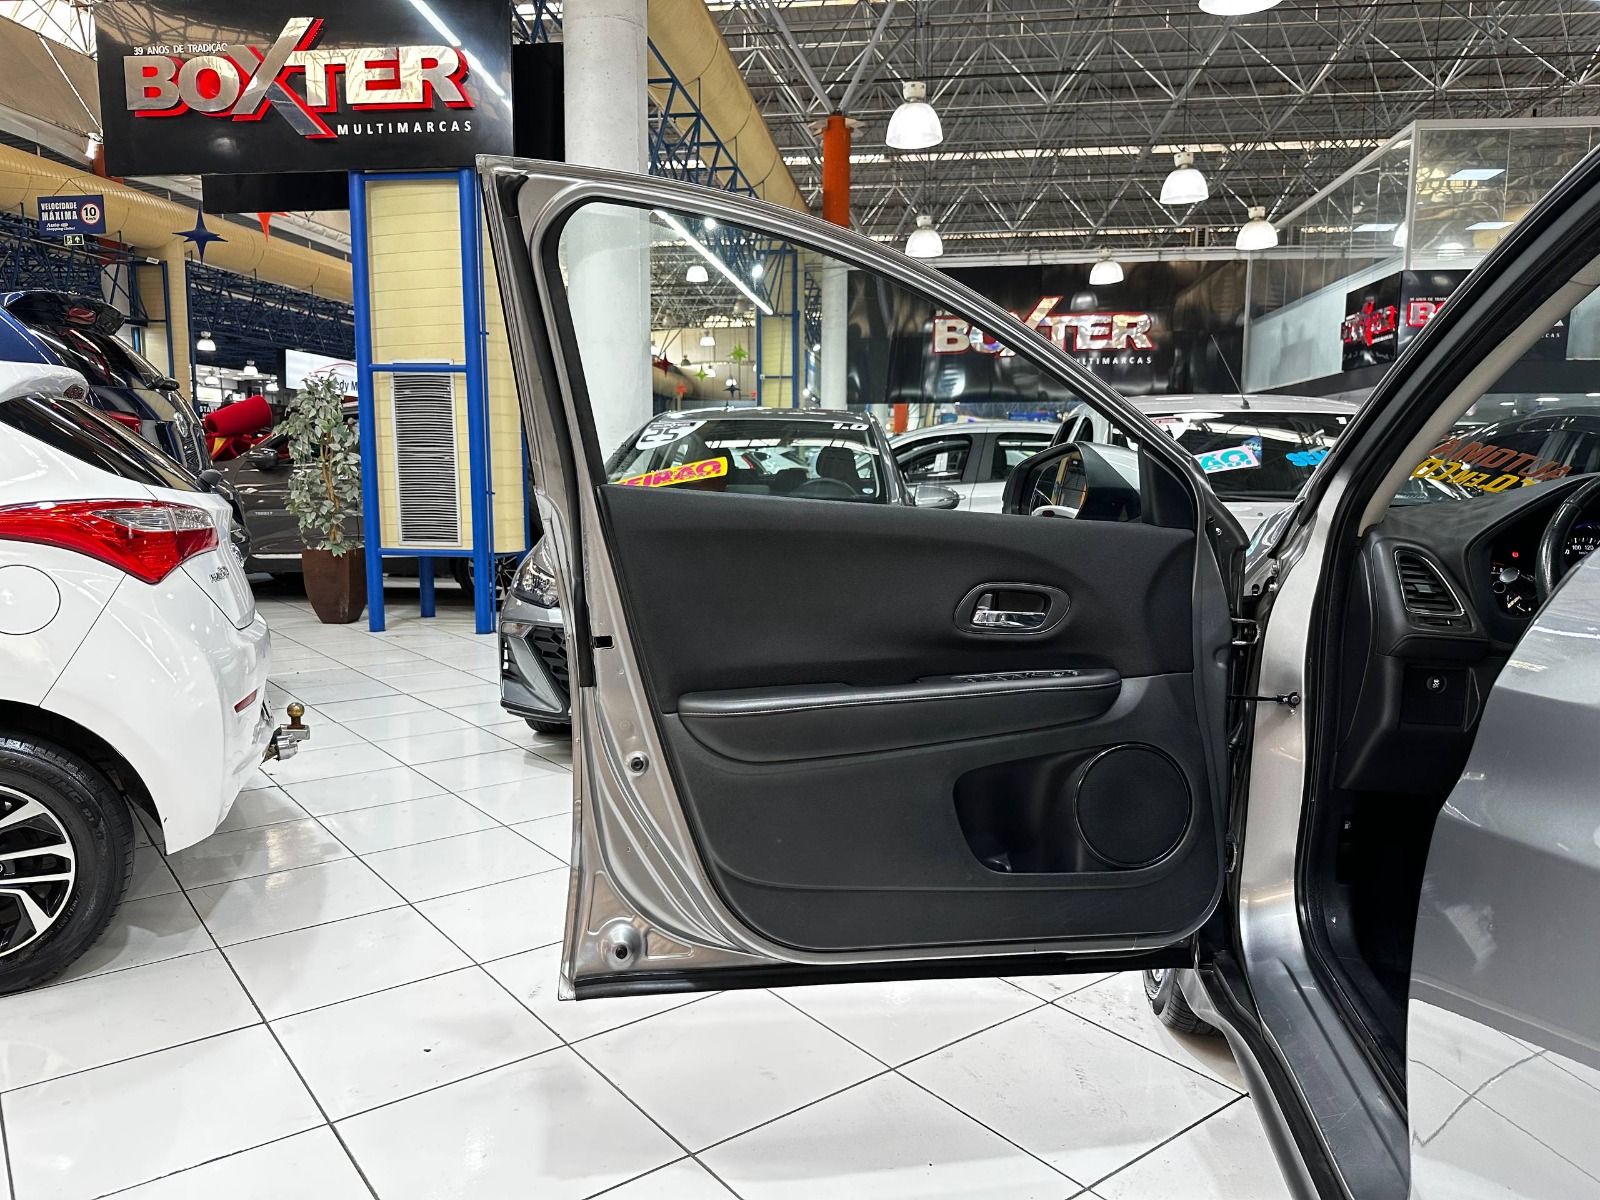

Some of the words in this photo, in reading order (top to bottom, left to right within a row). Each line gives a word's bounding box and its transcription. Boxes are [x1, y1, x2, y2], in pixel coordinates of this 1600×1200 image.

[133, 46, 144, 55] 39
[147, 44, 170, 55] ANOS
[173, 44, 185, 54] DE
[188, 41, 228, 54] TRADIÇÃO
[123, 17, 474, 138] BOXTER
[337, 120, 472, 135] MULTIMARCAS
[41, 202, 77, 210] VELOCIDADE
[41, 210, 78, 221] MÁXIMA
[83, 207, 97, 217] 10
[832, 423, 870, 431] 1.0
